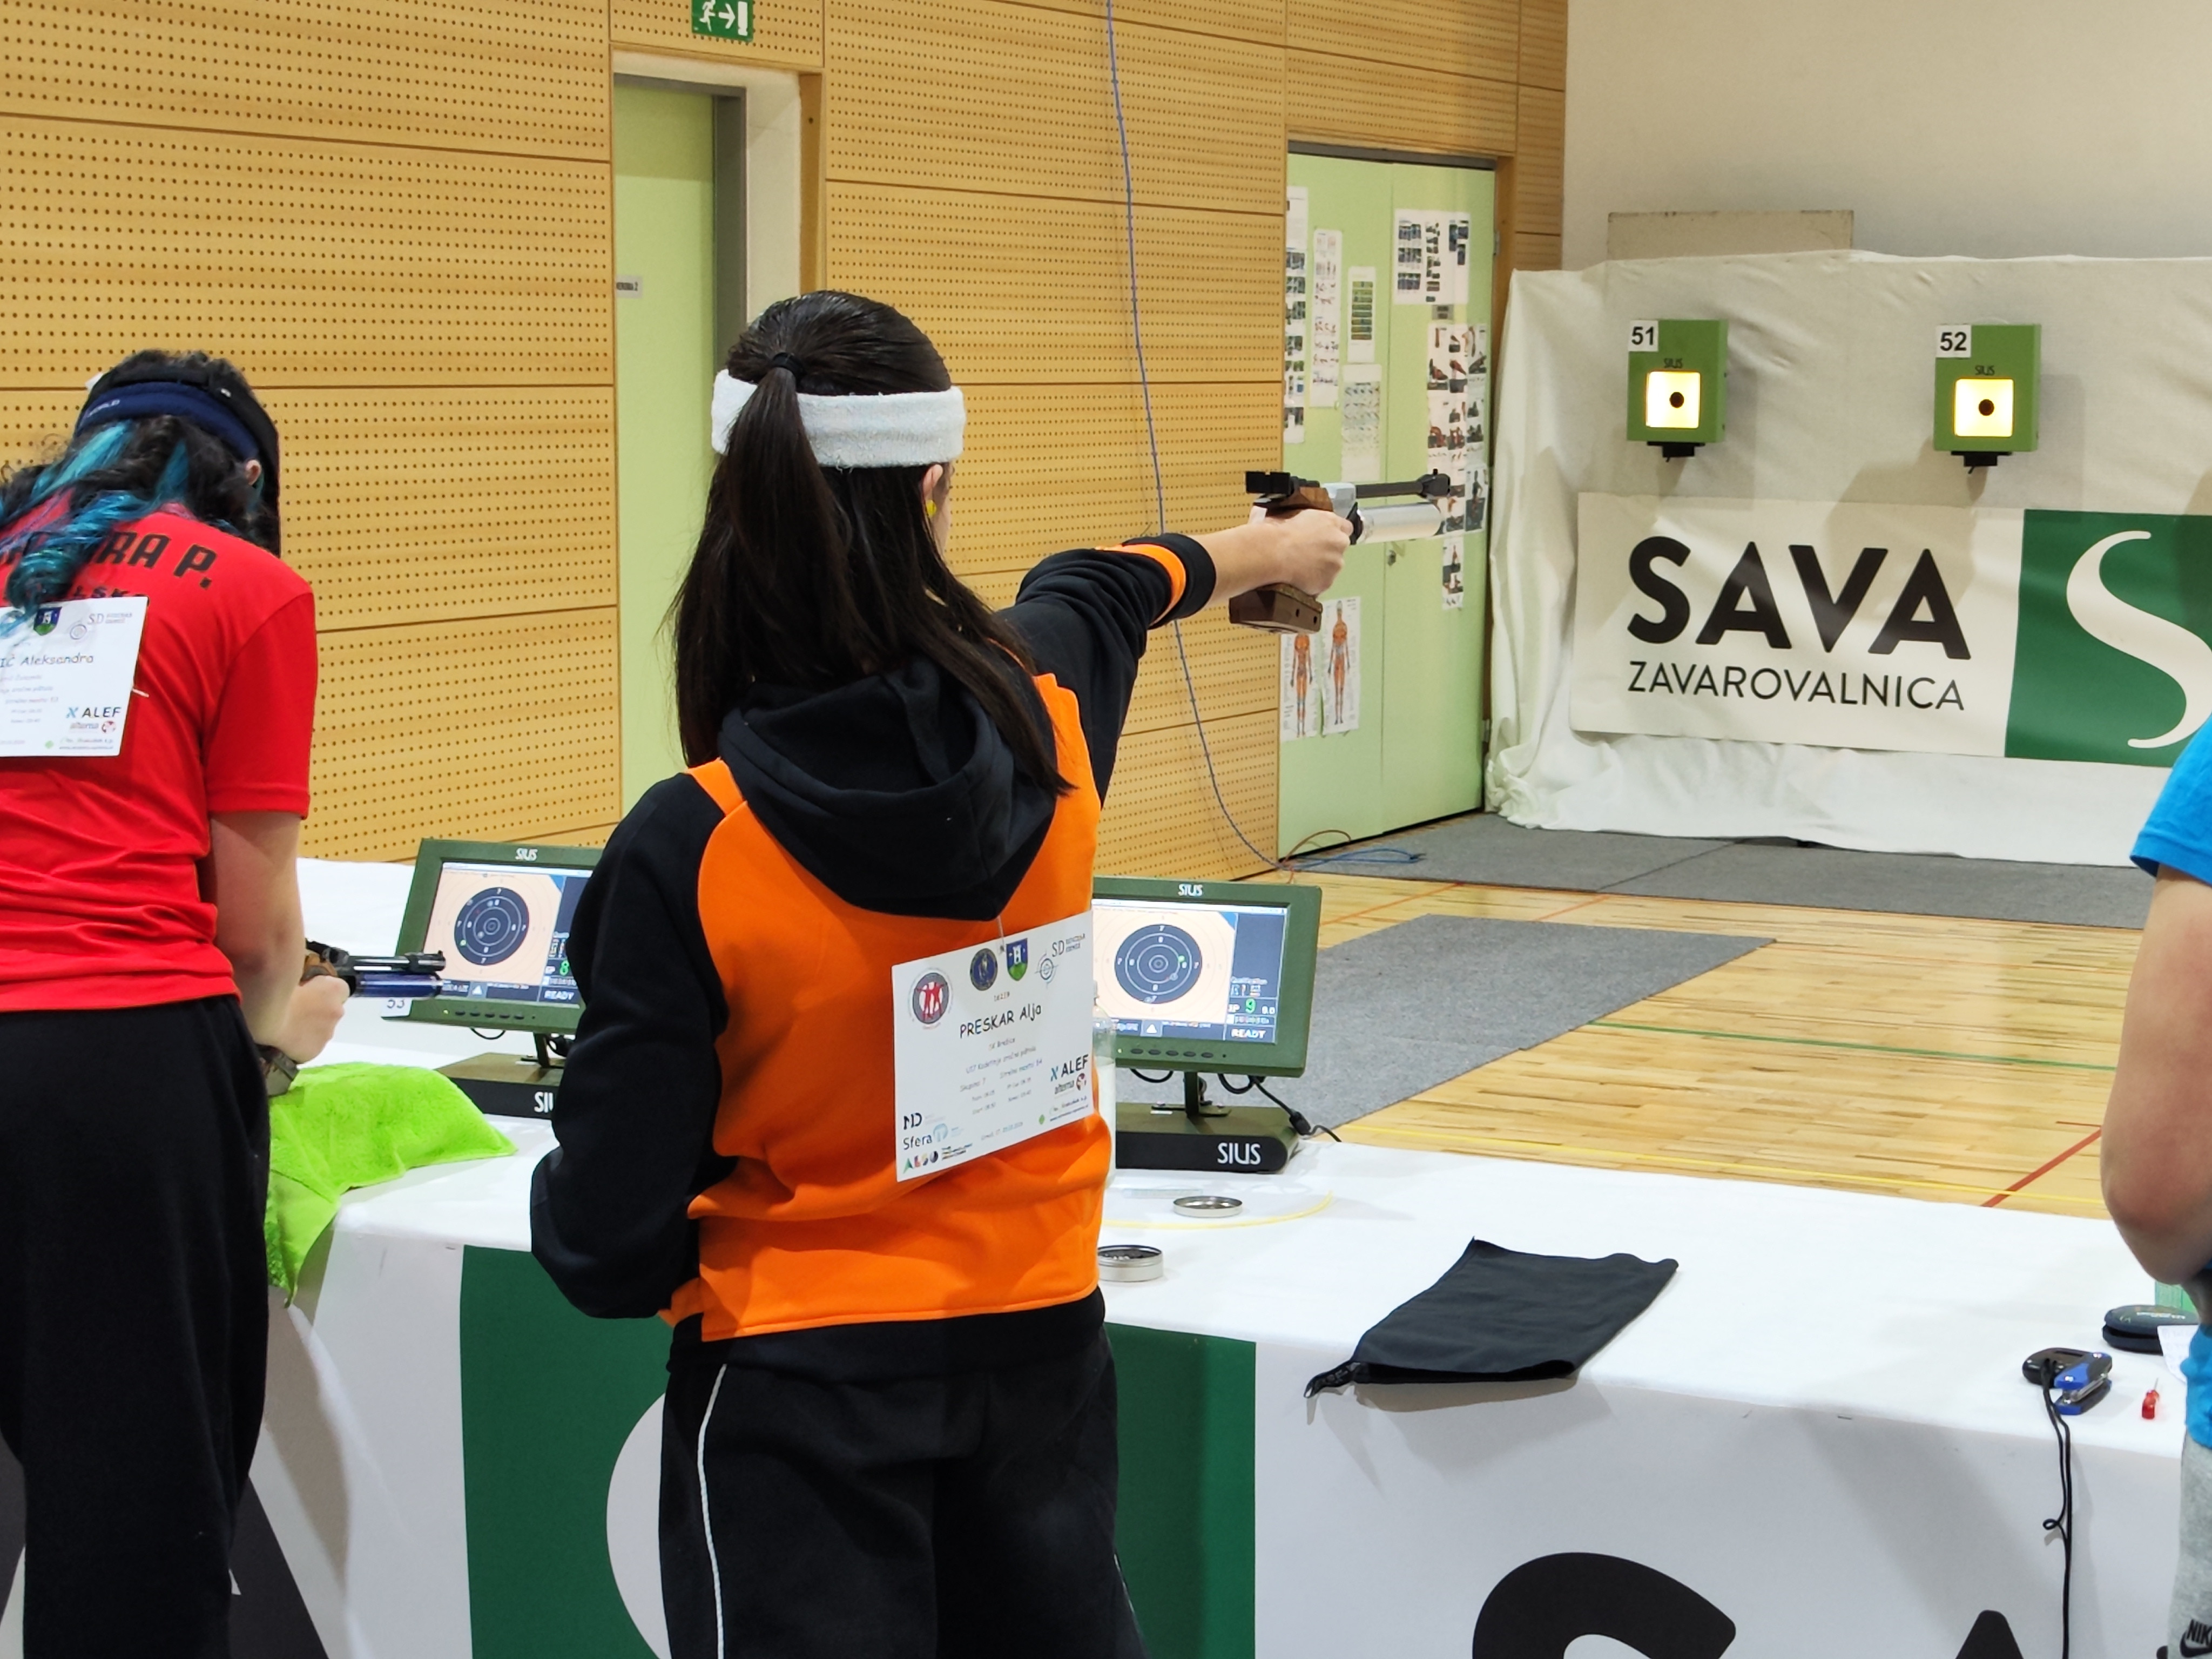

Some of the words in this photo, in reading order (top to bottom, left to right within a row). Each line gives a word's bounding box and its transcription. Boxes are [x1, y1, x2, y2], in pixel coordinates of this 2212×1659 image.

[1631, 326, 1654, 346] 51
[1940, 331, 1967, 352] 52
[1974, 365, 1995, 376] SIUS
[173, 543, 218, 590] P.
[1627, 535, 1972, 660] SAVA
[1627, 660, 1965, 711] ZAVAROVALNICA
[81, 706, 122, 719] ALEF
[1178, 884, 1203, 896] SIUS
[1052, 940, 1064, 957] SD
[1245, 997, 1256, 1014] 9
[960, 1010, 1015, 1039] PRESKAR
[1231, 1028, 1266, 1039] READY
[1061, 1054, 1089, 1078] ALEF
[534, 1091, 554, 1113] SI
[902, 1134, 933, 1150] Sfera
[1217, 1142, 1262, 1165] SIUS
[2186, 1618, 2212, 1646] NIK
